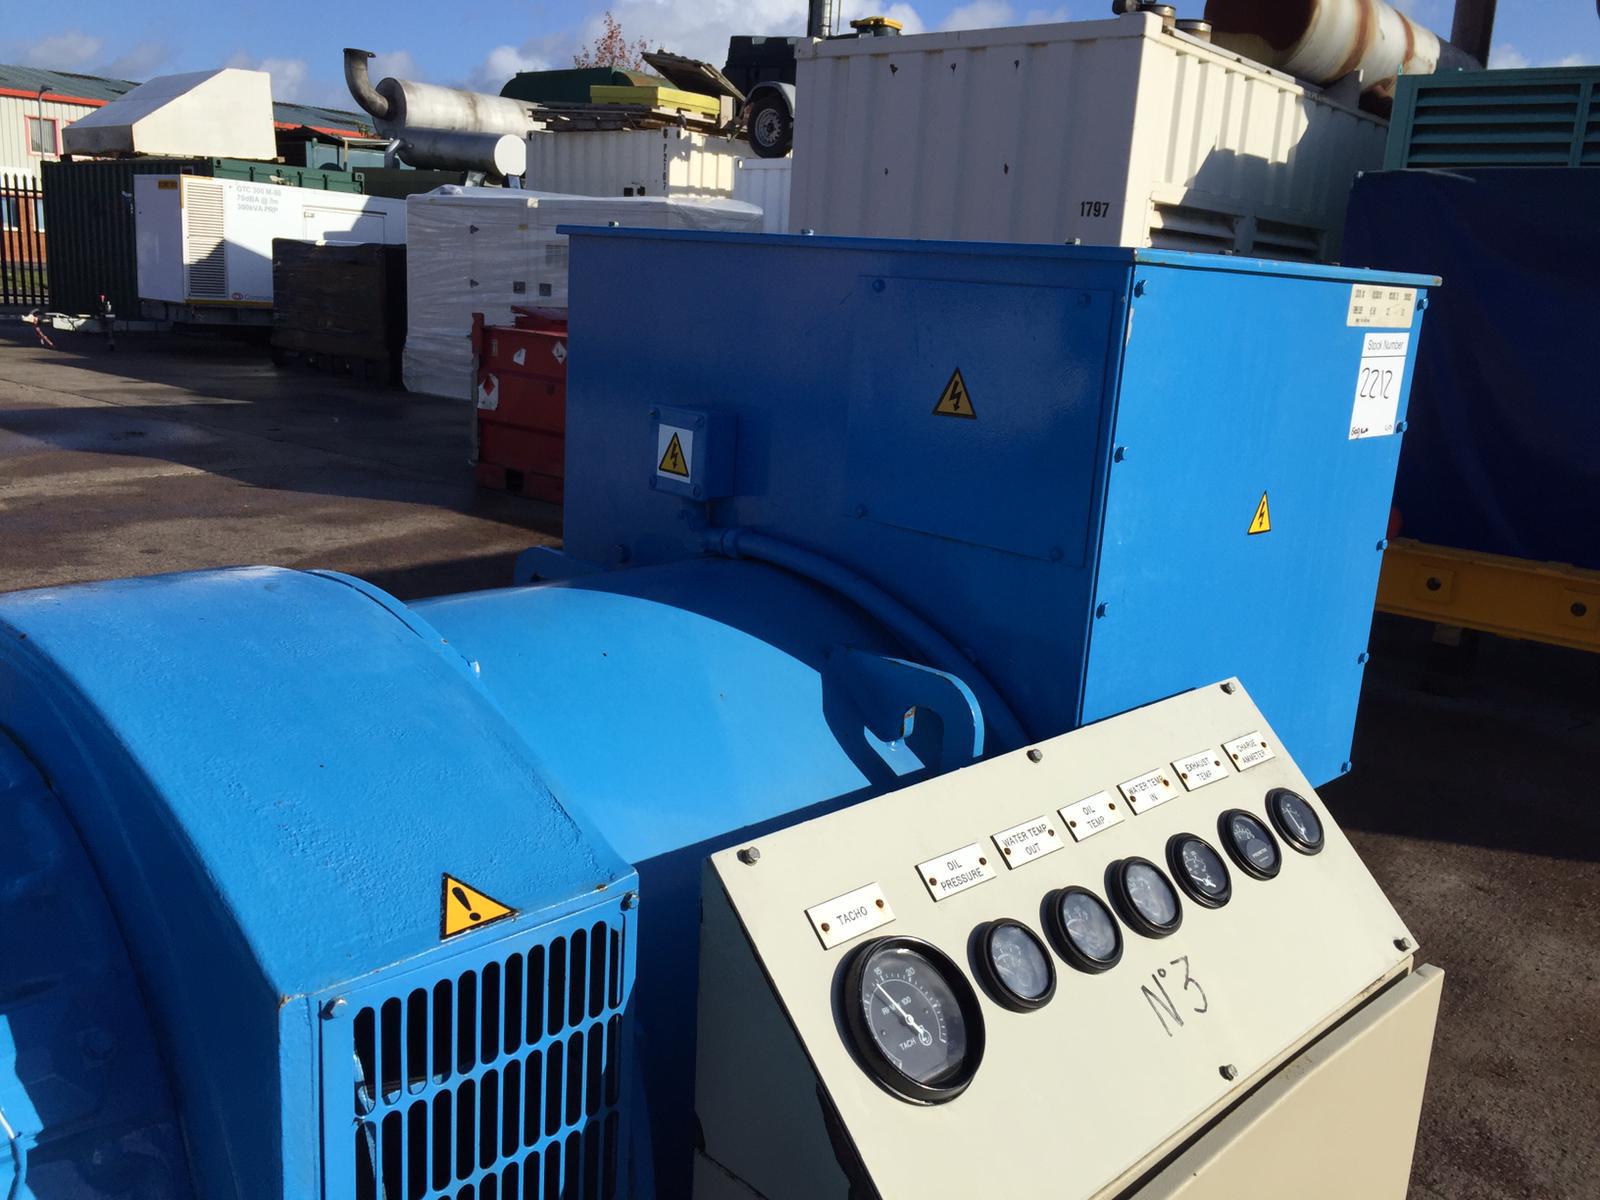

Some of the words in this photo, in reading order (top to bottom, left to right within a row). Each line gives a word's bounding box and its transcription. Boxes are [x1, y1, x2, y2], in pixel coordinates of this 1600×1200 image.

[1080, 201, 1110, 218] 1797
[1368, 339, 1383, 351] Stock
[1384, 340, 1404, 350] Number
[1360, 367, 1393, 399] 2212
[1236, 739, 1257, 752] CHARGE
[1242, 750, 1266, 764] AMMETER
[1184, 757, 1210, 772] EXHAUST
[1196, 770, 1212, 781] TEMP
[1126, 781, 1148, 795] WATER
[1147, 775, 1164, 788] TEMP
[1150, 793, 1159, 802] IN
[1082, 805, 1096, 816] OIL
[1086, 816, 1105, 829] TEMP
[1002, 828, 1029, 848] WATER
[1027, 823, 1048, 839] TEMP
[1024, 842, 1041, 856] OUT
[946, 859, 963, 871] OIL
[940, 867, 984, 891] PRESSURE
[836, 905, 868, 926] TACHO
[904, 966, 916, 977] 20
[899, 1037, 917, 1050] TACH
